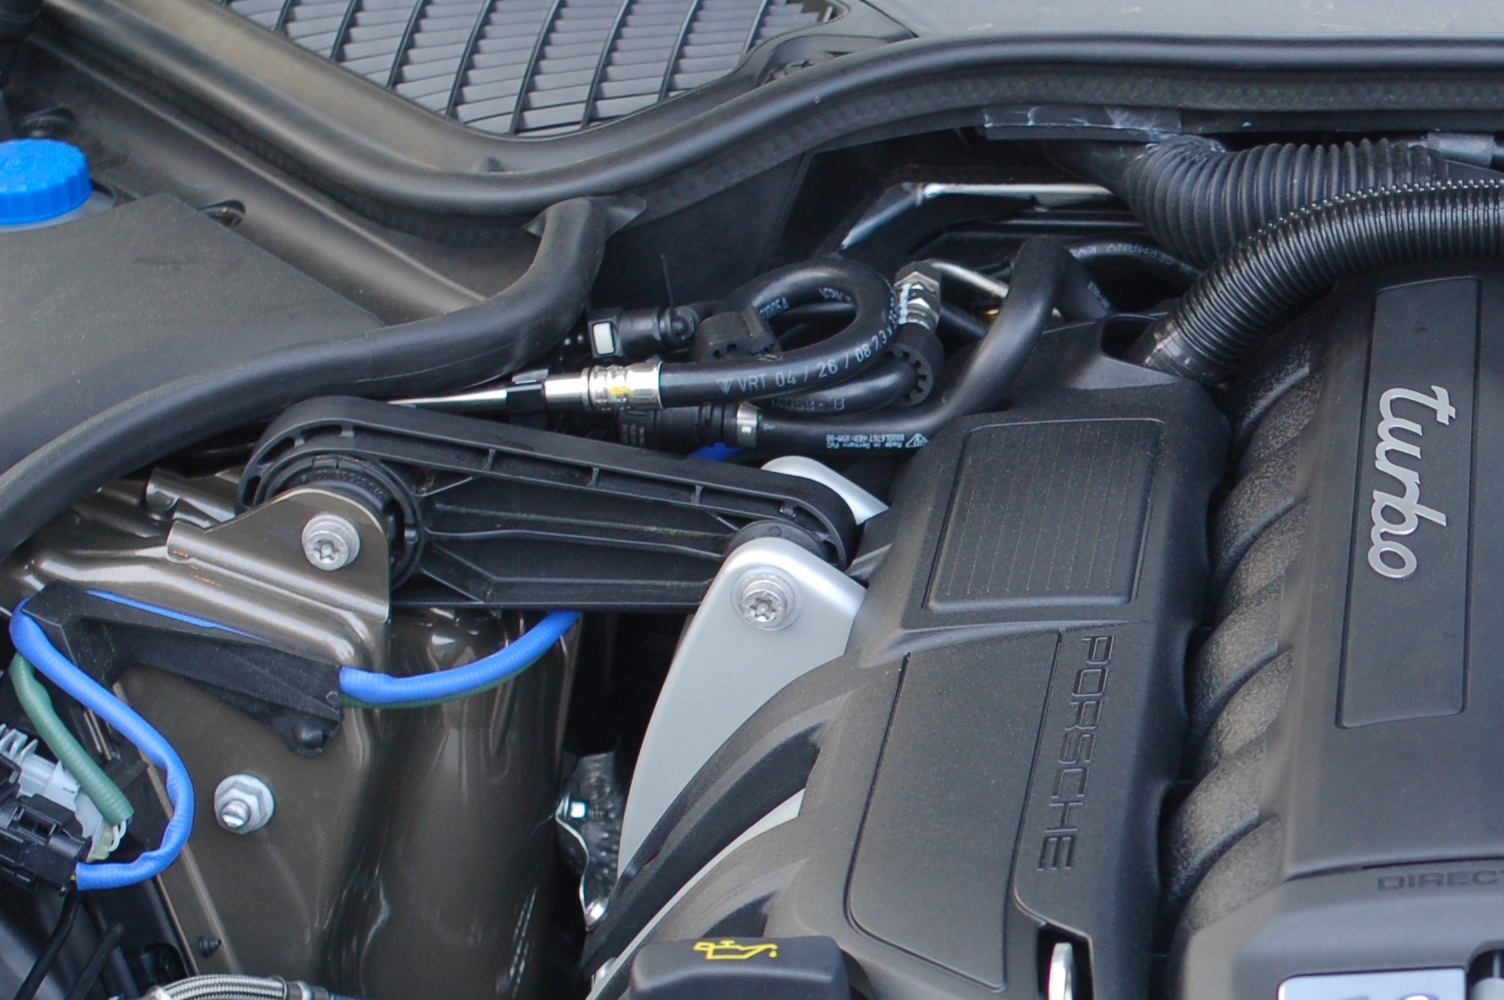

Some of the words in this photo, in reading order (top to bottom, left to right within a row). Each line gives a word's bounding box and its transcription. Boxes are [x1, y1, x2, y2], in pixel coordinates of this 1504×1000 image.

[1107, 243, 1176, 266] GERMANY
[736, 373, 766, 393] VRT
[774, 371, 797, 389] 04
[816, 359, 839, 379] 26
[854, 344, 872, 363] 08
[1365, 384, 1459, 581] turbo
[1036, 632, 1115, 875] PORSCHE
